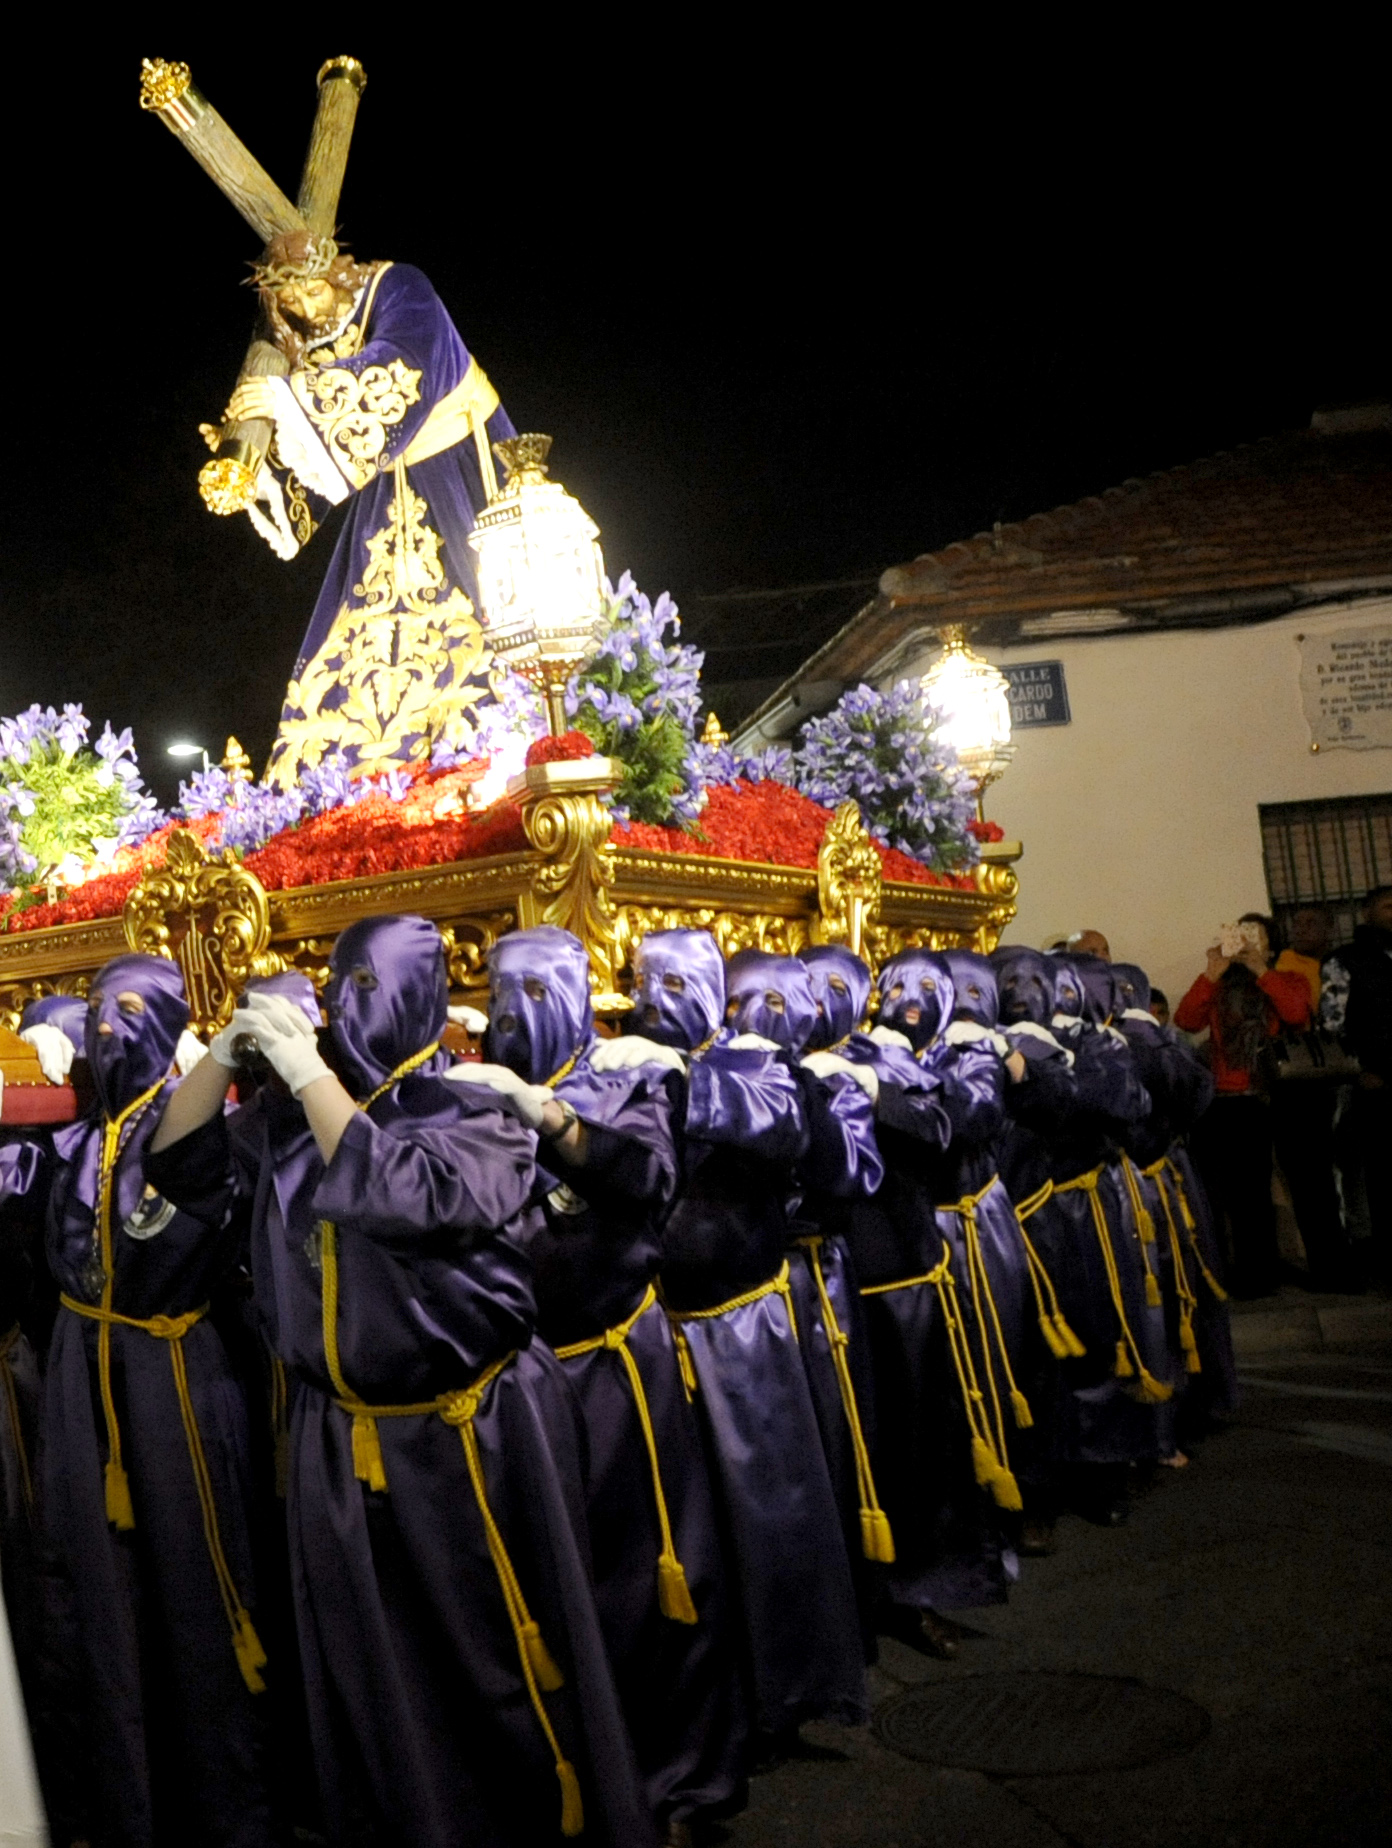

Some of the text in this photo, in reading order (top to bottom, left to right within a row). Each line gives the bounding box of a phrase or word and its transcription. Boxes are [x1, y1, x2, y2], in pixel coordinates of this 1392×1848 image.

[1008, 668, 1051, 684] ALLE
[1009, 683, 1053, 703] CARDO
[1013, 703, 1047, 722] DEM
